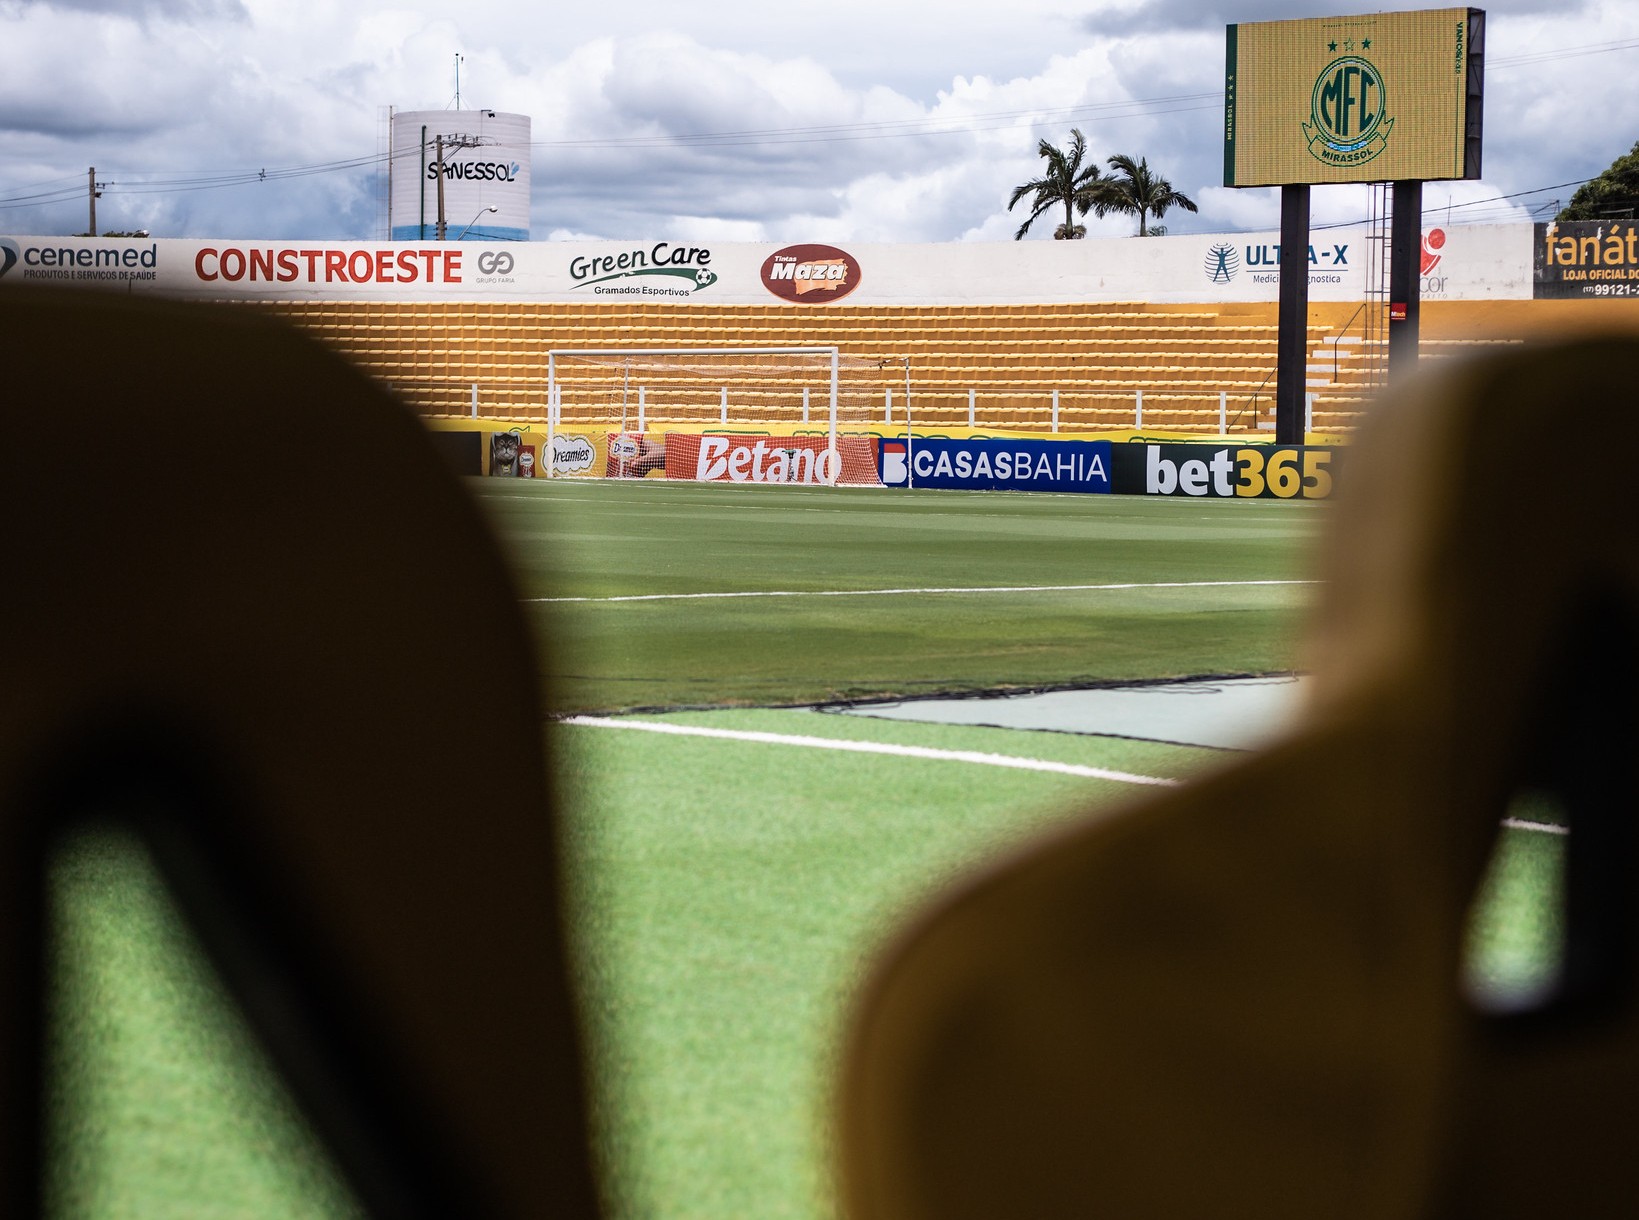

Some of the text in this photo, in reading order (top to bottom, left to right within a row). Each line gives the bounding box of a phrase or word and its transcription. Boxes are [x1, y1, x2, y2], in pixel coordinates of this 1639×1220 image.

[1321, 66, 1375, 136] MFC
[1321, 148, 1373, 162] MIRASSOL
[427, 161, 515, 182] SANESSOL
[24, 243, 157, 268] cenemed
[570, 243, 711, 280] Green Care
[1246, 245, 1348, 265] ULTA-X
[24, 269, 157, 281] PRODUTOS E SERVIÇOS DE SAÚDE
[195, 248, 462, 283] CONSTROESTE
[770, 263, 846, 280] Maza
[1563, 270, 1587, 280] LOJA
[1589, 269, 1627, 280] OFICIAL
[1253, 275, 1341, 285] Medici gnostica
[1420, 277, 1448, 293] cor
[594, 286, 690, 297] Gramados Esportivos
[697, 437, 841, 484] Betano
[1146, 445, 1332, 498] bet365
